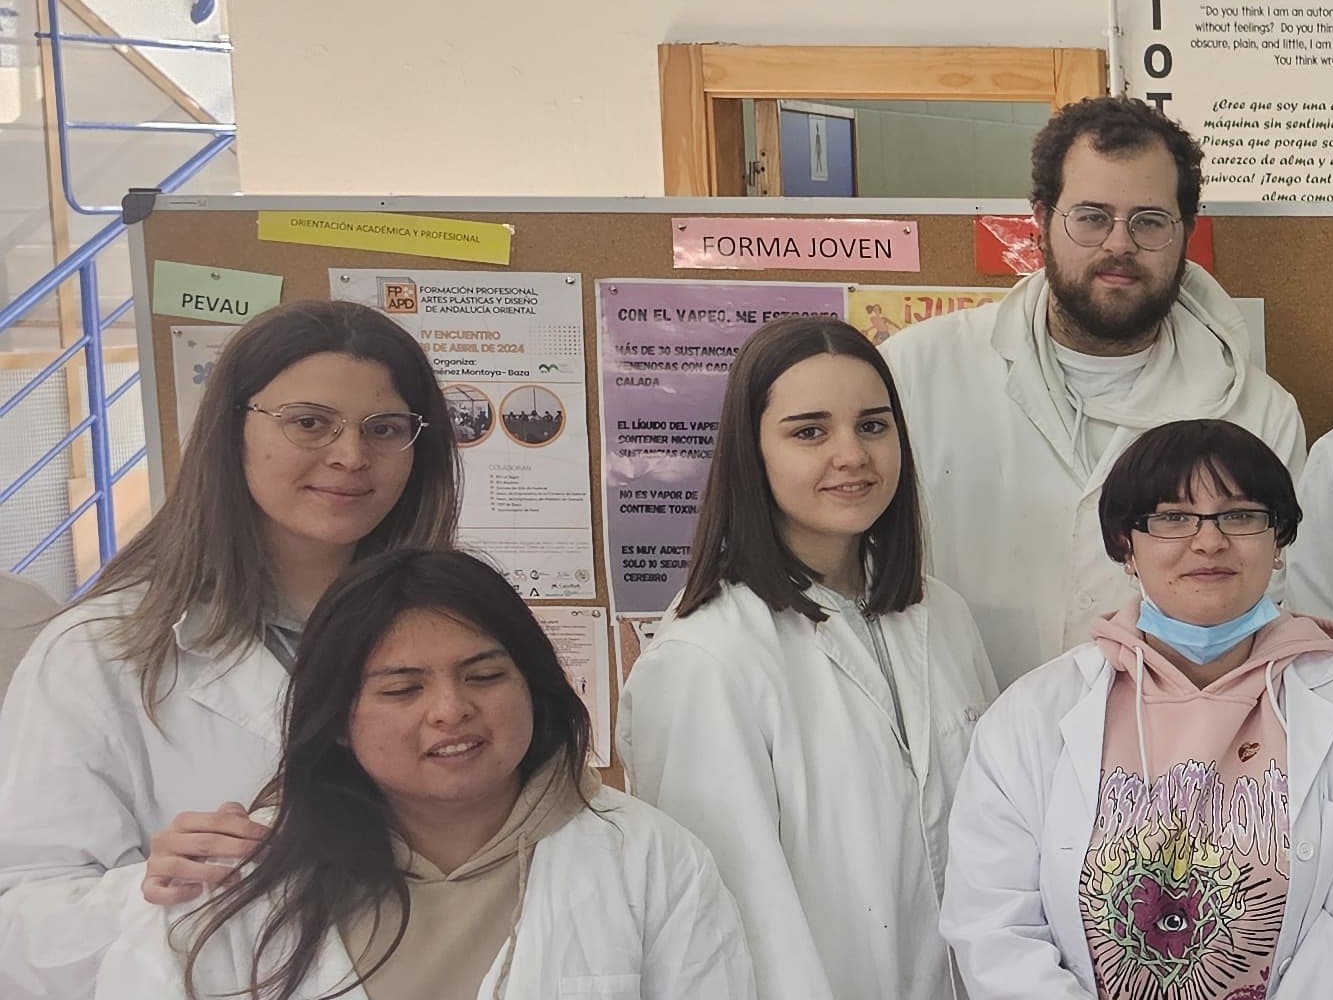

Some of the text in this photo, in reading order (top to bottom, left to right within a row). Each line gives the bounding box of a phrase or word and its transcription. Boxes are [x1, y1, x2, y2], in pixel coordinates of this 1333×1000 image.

[1221, 8, 1238, 18] you
[1242, 6, 1264, 17] think
[1195, 21, 1231, 33] without
[1234, 21, 1275, 35] feelings?
[1296, 24, 1314, 36] you
[1190, 38, 1231, 50] obscure,
[1233, 38, 1259, 52] plain,
[1261, 39, 1280, 49] and
[1283, 38, 1307, 50] little,
[1274, 54, 1318, 66] You think
[1212, 98, 1246, 113] ¿Cree
[1249, 101, 1272, 113] que
[1276, 101, 1298, 113] soy
[1302, 101, 1327, 112] una
[1203, 116, 1260, 131] máquina
[1263, 117, 1282, 130] sin
[1202, 134, 1244, 148] Piensa
[1247, 138, 1271, 149] que
[1274, 137, 1318, 150] porque
[1211, 155, 1257, 166] carezco
[1260, 153, 1276, 166] de
[1279, 154, 1315, 168] alma
[1260, 172, 1302, 187] ¡Tengo
[1262, 191, 1297, 202] alma
[290, 217, 481, 244] ORIENTACIÓN ACADÉMICA PROFESIONAL
[703, 235, 893, 259] FORMA JOVEN
[420, 284, 474, 296] FORMACIÓN
[181, 293, 250, 317] PEVAU
[388, 298, 415, 310] APD
[421, 295, 538, 306] ARTES DISEÑO
[425, 304, 537, 315] DE ANDALUCÍA ORIENTAL
[617, 308, 648, 323] CON
[653, 308, 672, 322] EL
[736, 310, 757, 324] ME
[420, 329, 501, 341] IV ENCUENTRO
[450, 342, 526, 354] ABRIL 2024
[640, 346, 656, 357] DE
[657, 346, 672, 356] 30
[674, 346, 739, 358] SUSTANCIAS
[433, 357, 477, 368] Organiza:
[508, 368, 531, 377] Baza
[615, 376, 660, 387] CALADA
[632, 418, 667, 431] LÍQUIDO
[669, 421, 688, 431] DEL
[618, 434, 714, 446] CONTENER NICOTINA
[650, 490, 683, 501] VAPOR
[619, 504, 698, 515] CONTIENE TOXIN
[636, 545, 657, 555] MUY
[622, 559, 658, 569] SOLO 10
[623, 572, 668, 582] CEREBRO
